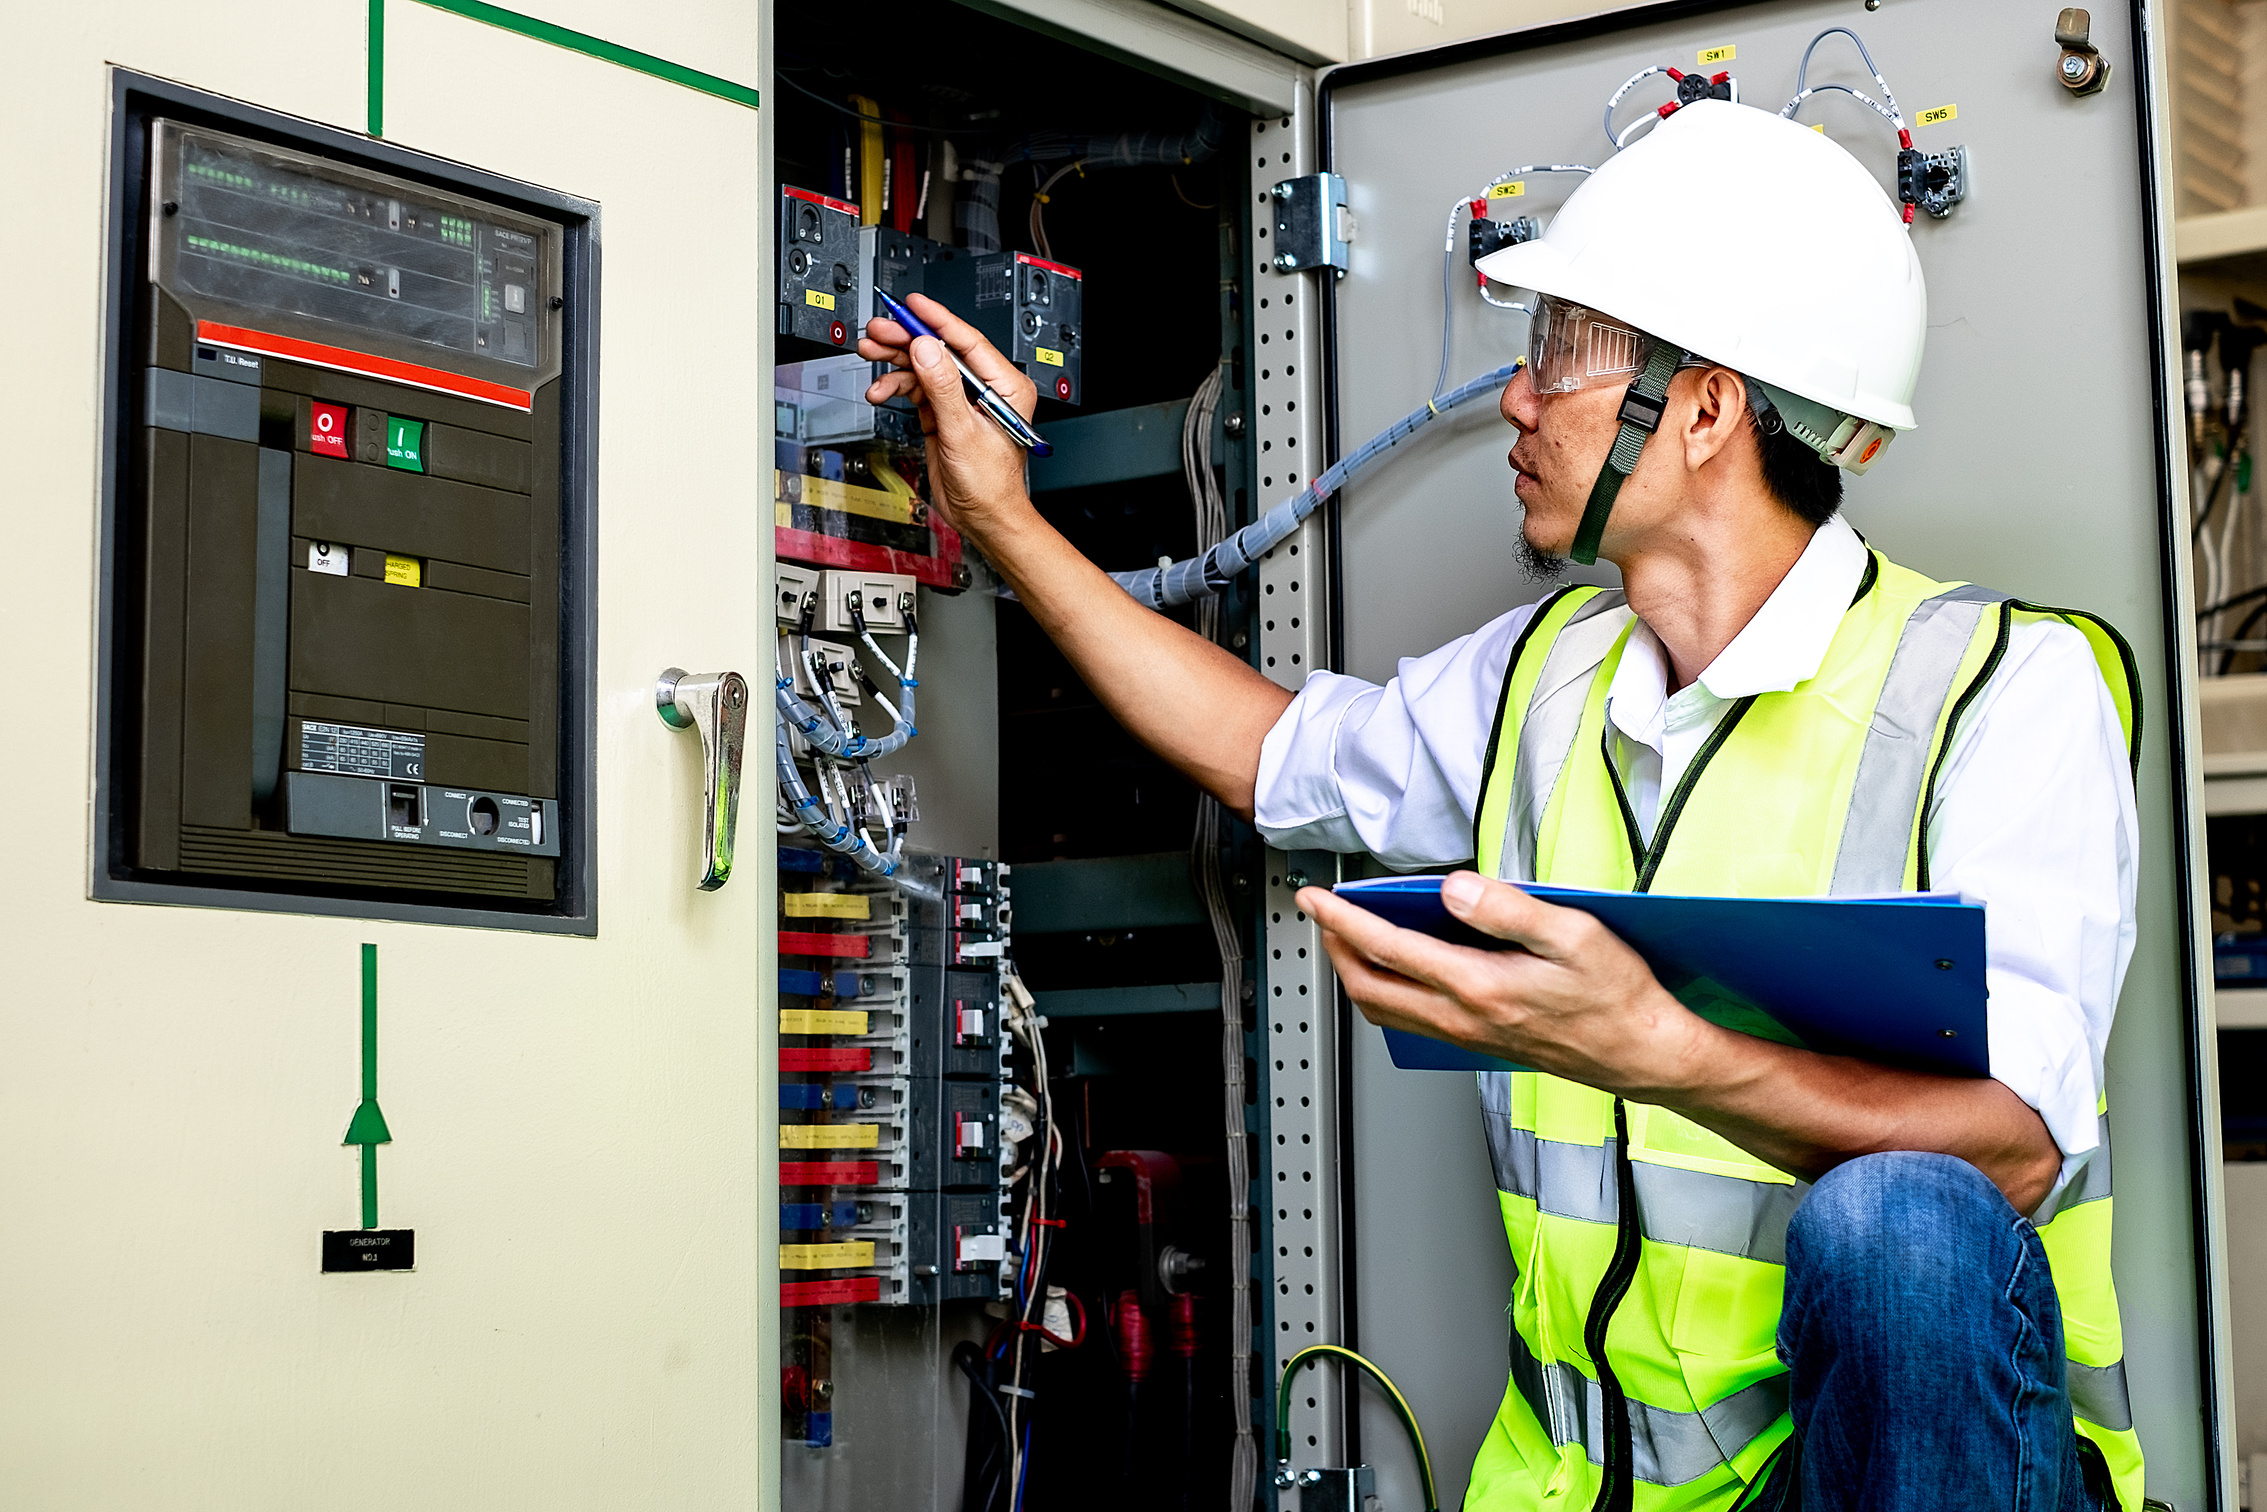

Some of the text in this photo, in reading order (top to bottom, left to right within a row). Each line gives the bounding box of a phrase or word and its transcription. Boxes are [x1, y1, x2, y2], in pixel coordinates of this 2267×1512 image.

[1706, 49, 1725, 61] SW1
[1925, 108, 1947, 122] SW5
[1497, 184, 1516, 196] SW2
[815, 294, 825, 305] Q1
[224, 354, 259, 369] T.U. Reset
[1044, 351, 1054, 362] Q2
[311, 434, 344, 446] ush OFF
[404, 450, 418, 460] ON
[317, 558, 331, 567] OFF
[386, 562, 412, 571] HARGED
[385, 570, 407, 580] SPRING
[502, 799, 528, 807] CONNECTED
[403, 826, 422, 834] BEFORE
[440, 831, 468, 839] DISCONNECT
[394, 832, 420, 840] OPERATING
[497, 837, 530, 845] DISCONNECTED
[349, 1237, 391, 1247] GENERATOR
[362, 1253, 378, 1262] NO.1
